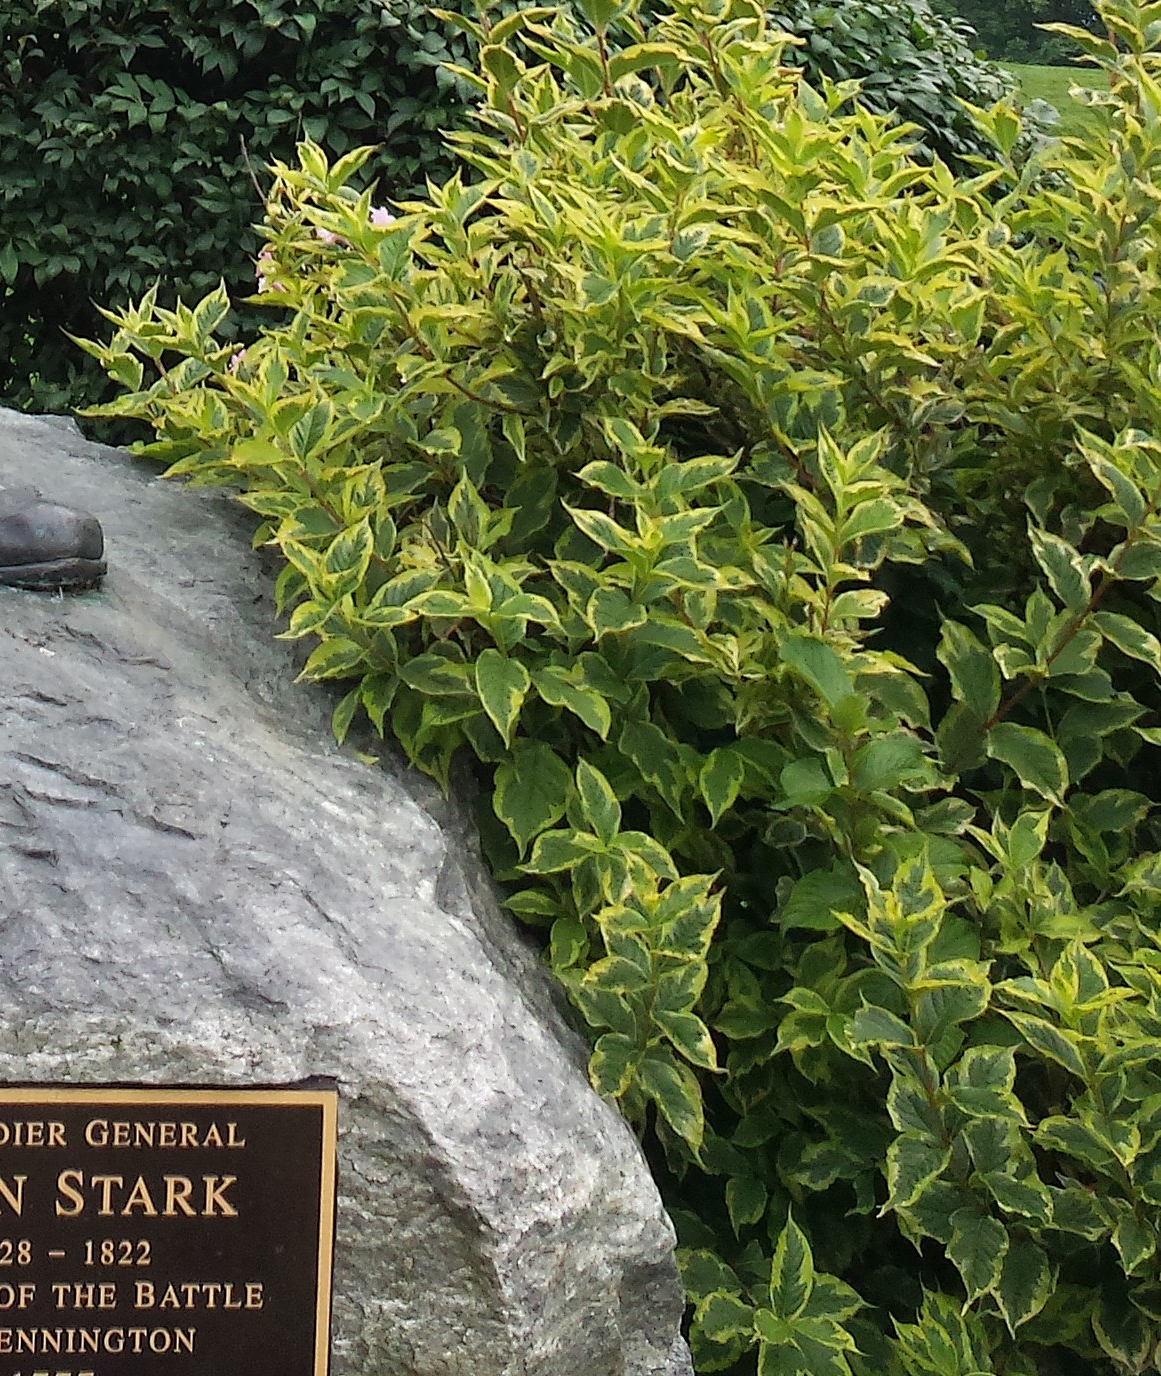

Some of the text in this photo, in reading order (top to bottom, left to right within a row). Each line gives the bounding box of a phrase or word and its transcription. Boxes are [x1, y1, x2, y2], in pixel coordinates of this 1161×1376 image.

[84, 1119, 247, 1147] GENERAL
[55, 1169, 240, 1218] STARK
[84, 1239, 153, 1266] 1822
[52, 1282, 117, 1309] THE
[134, 1281, 265, 1309] BATTLE
